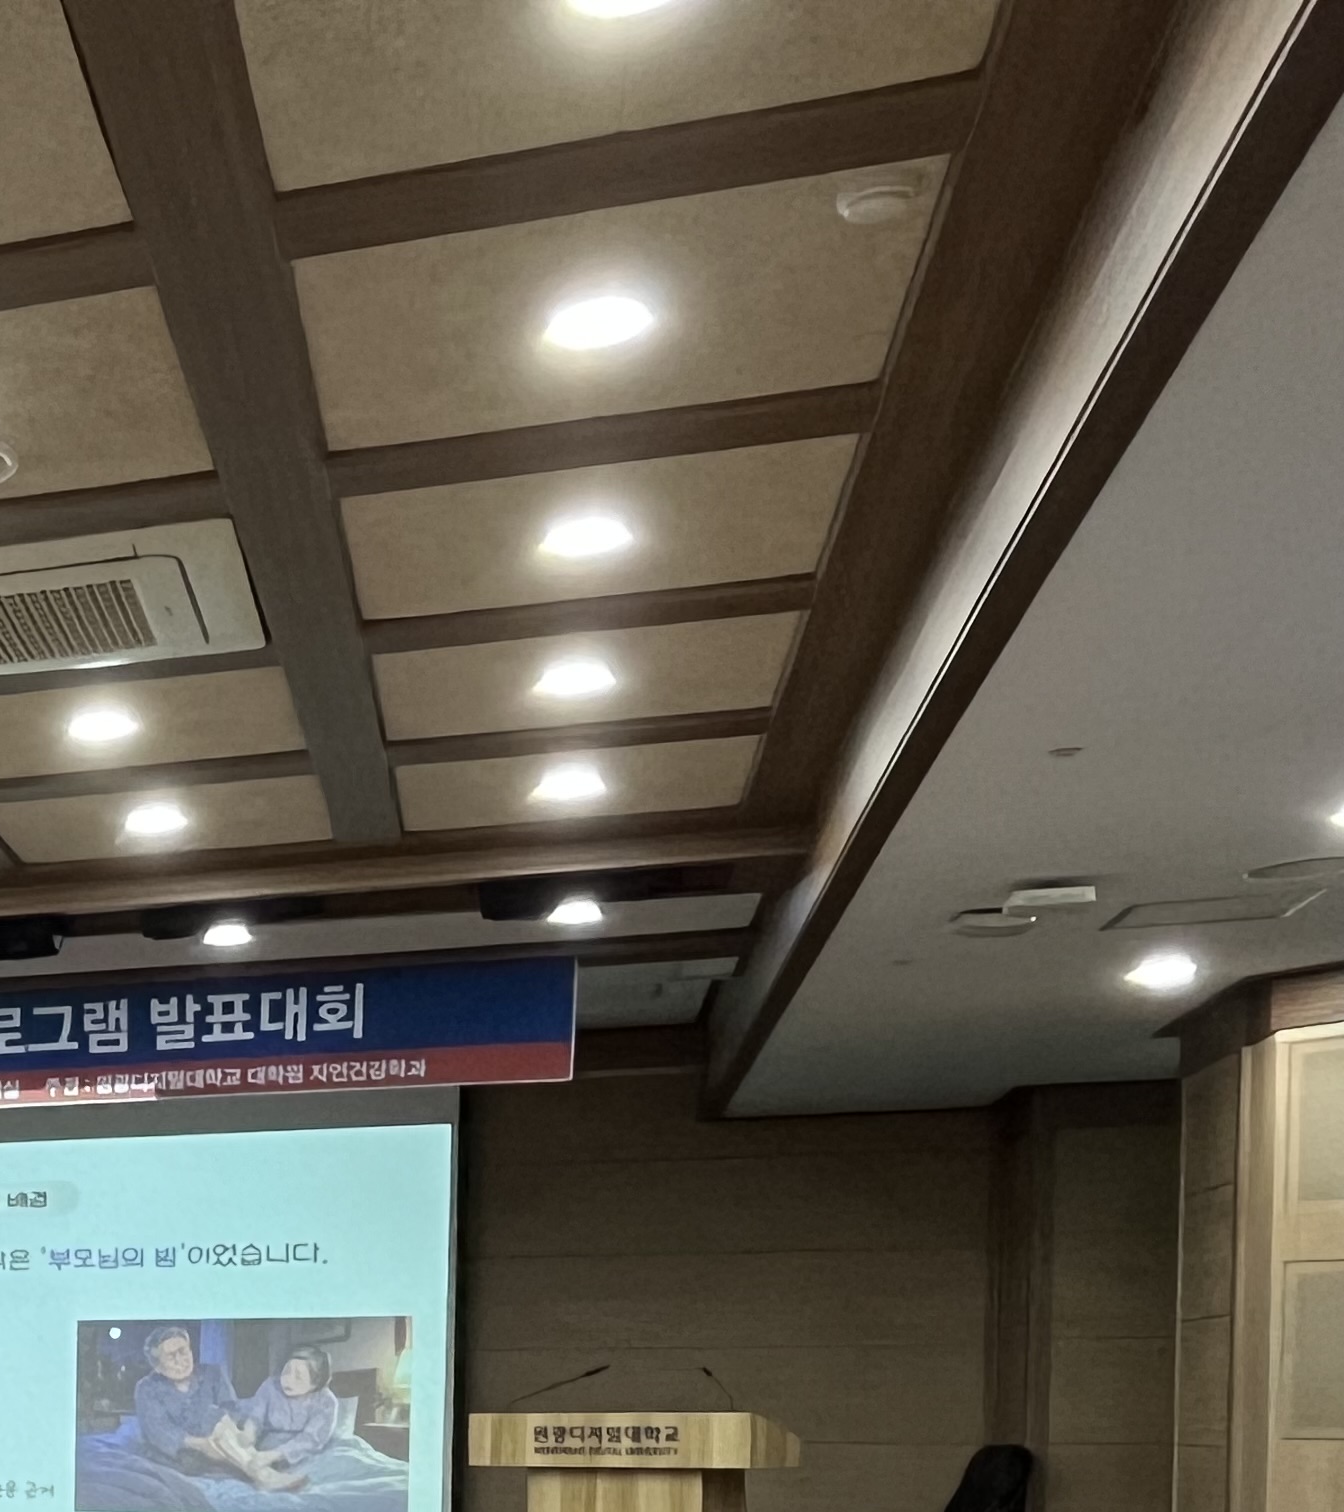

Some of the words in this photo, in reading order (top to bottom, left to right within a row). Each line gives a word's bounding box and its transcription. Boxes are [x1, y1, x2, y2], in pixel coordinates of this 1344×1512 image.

[150, 983, 365, 1051] 발표대회
[247, 1064, 304, 1086] 대학원
[309, 1058, 426, 1083] 자연건강학과
[7, 1191, 48, 1208] 배경
